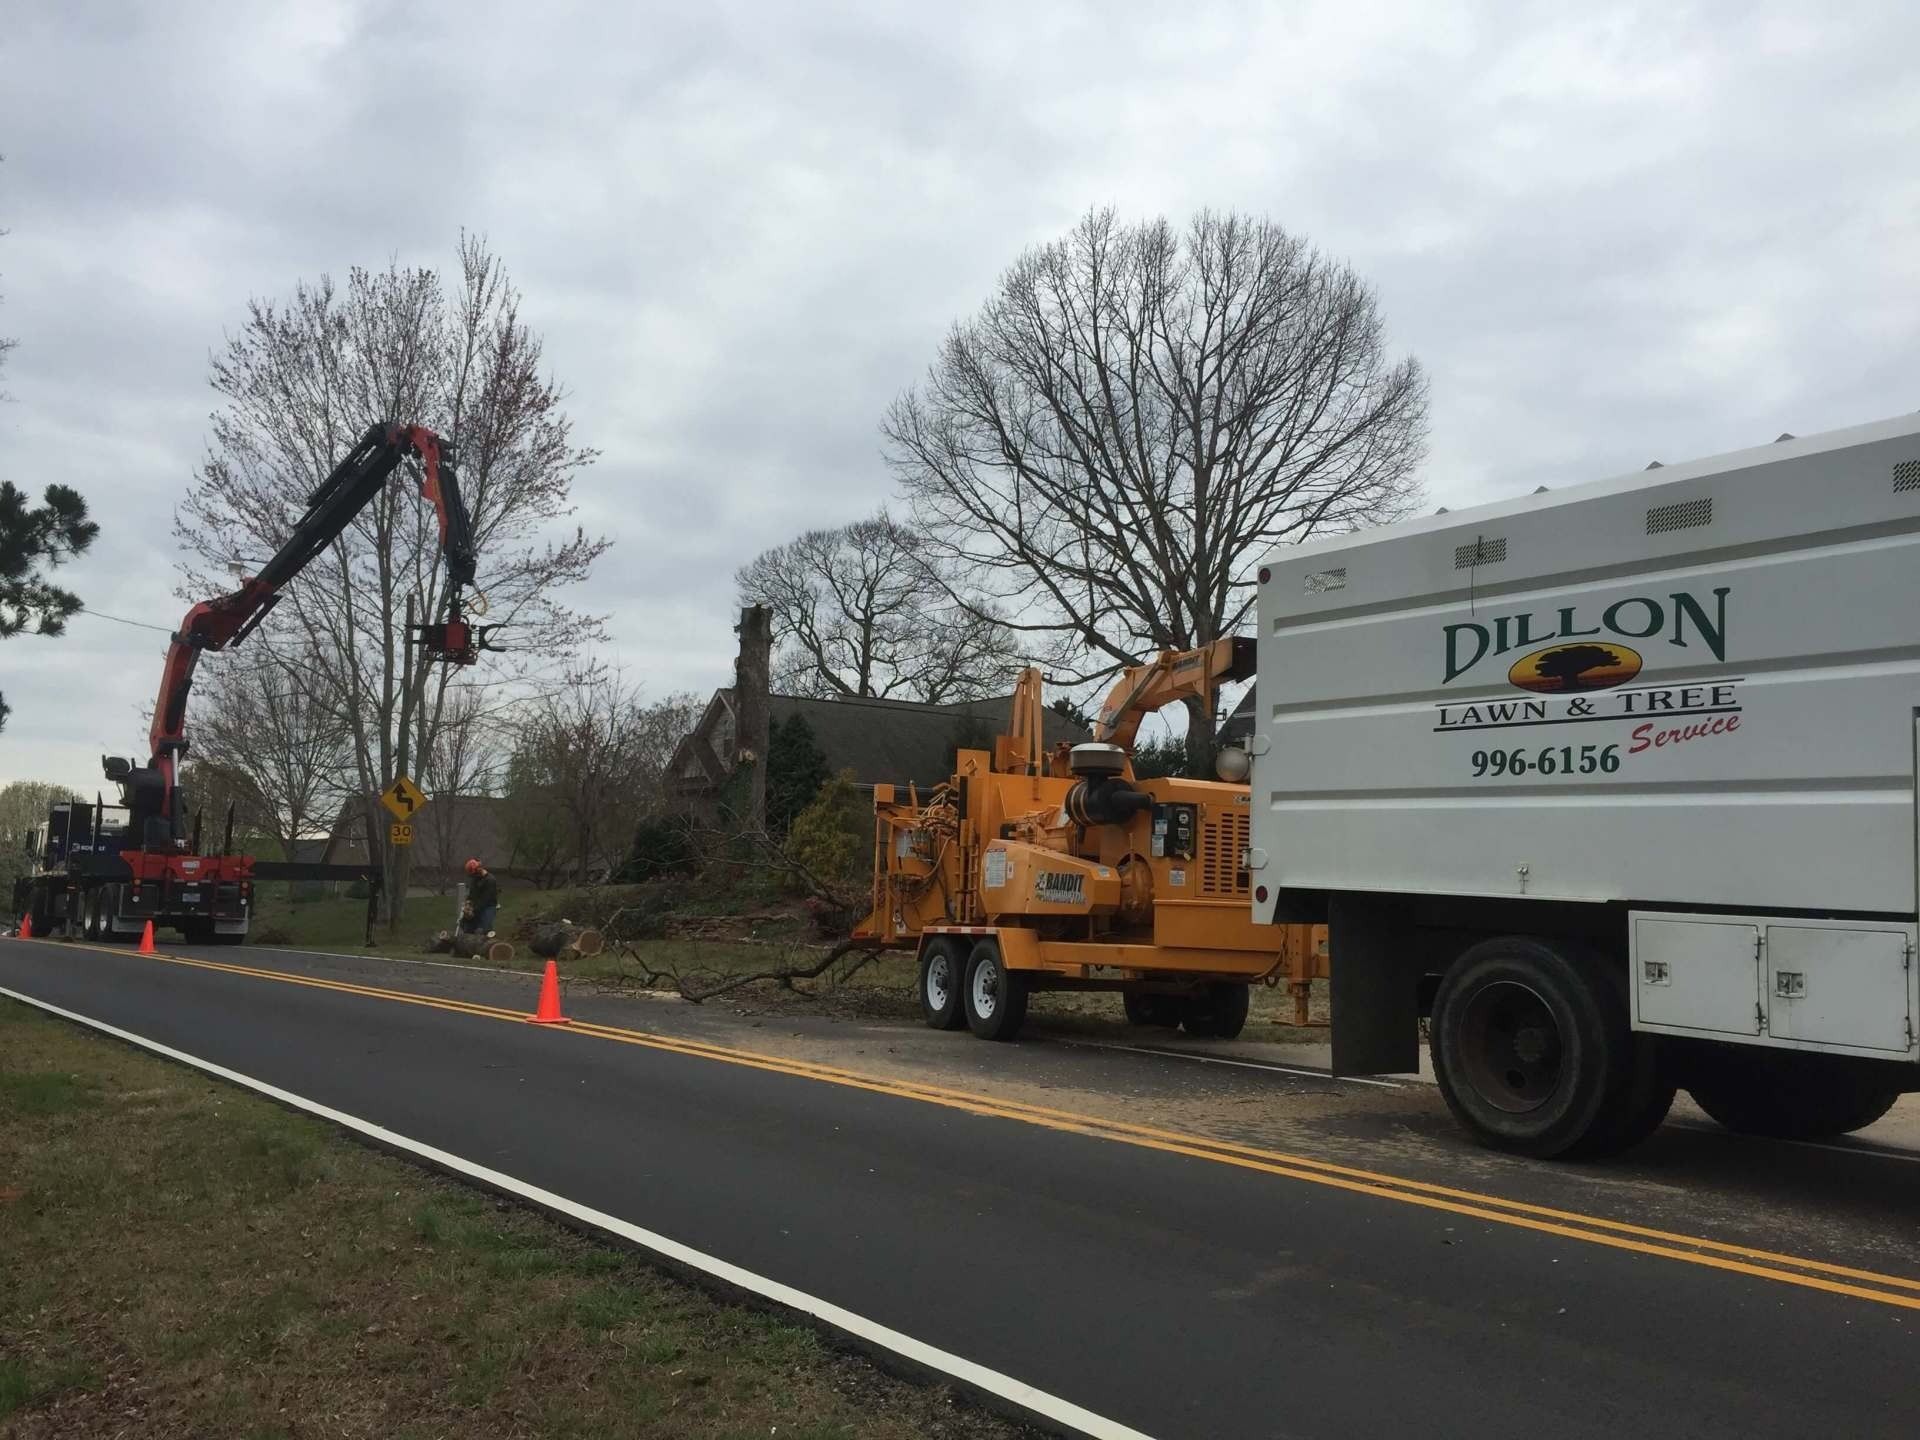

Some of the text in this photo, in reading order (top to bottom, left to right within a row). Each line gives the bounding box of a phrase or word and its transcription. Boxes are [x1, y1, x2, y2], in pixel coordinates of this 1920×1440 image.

[1442, 587, 1730, 684] DILLON
[1439, 685, 1737, 726] LAWN & TREE
[1628, 716, 1741, 754] Service
[1471, 744, 1620, 777] 996-6156
[392, 825, 411, 837] 30
[1045, 872, 1085, 892] BANDIT
